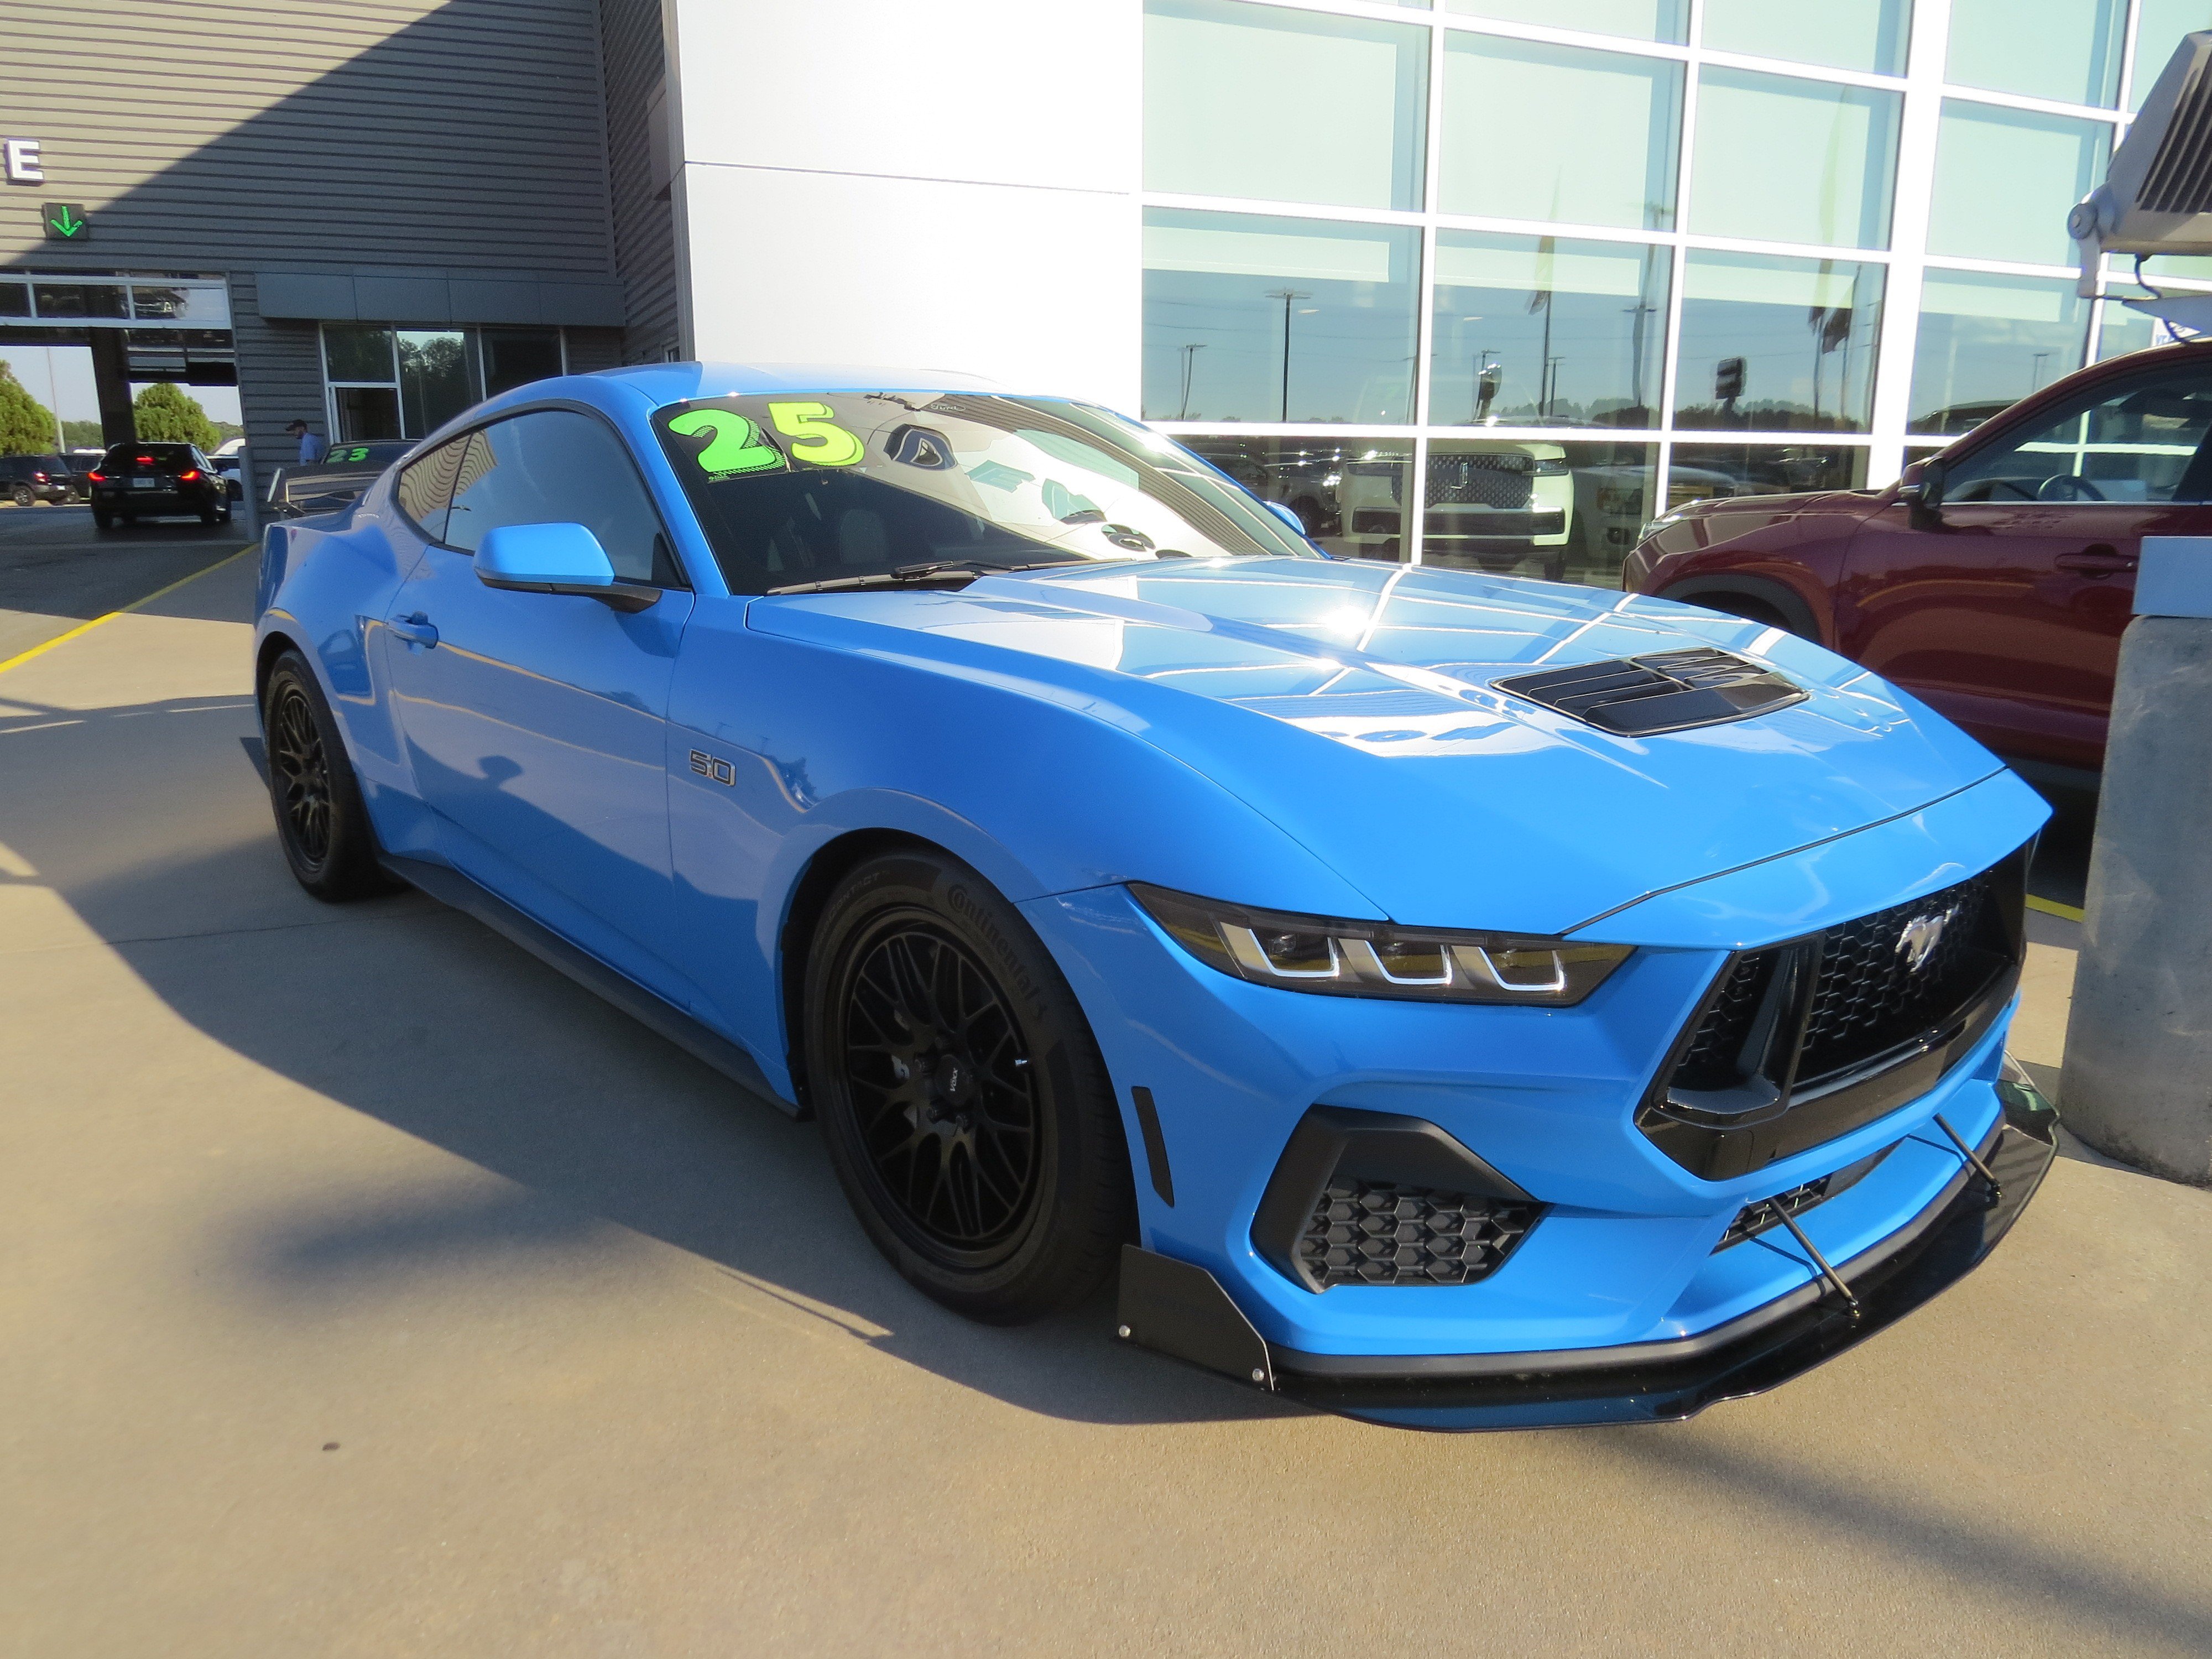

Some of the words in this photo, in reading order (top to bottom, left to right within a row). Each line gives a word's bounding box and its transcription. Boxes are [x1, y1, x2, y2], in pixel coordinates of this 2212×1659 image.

[7, 139, 44, 181] E
[326, 447, 369, 463] 23
[668, 401, 865, 477] 25
[690, 749, 736, 786] 5.0
[947, 884, 1041, 1001] Continental
